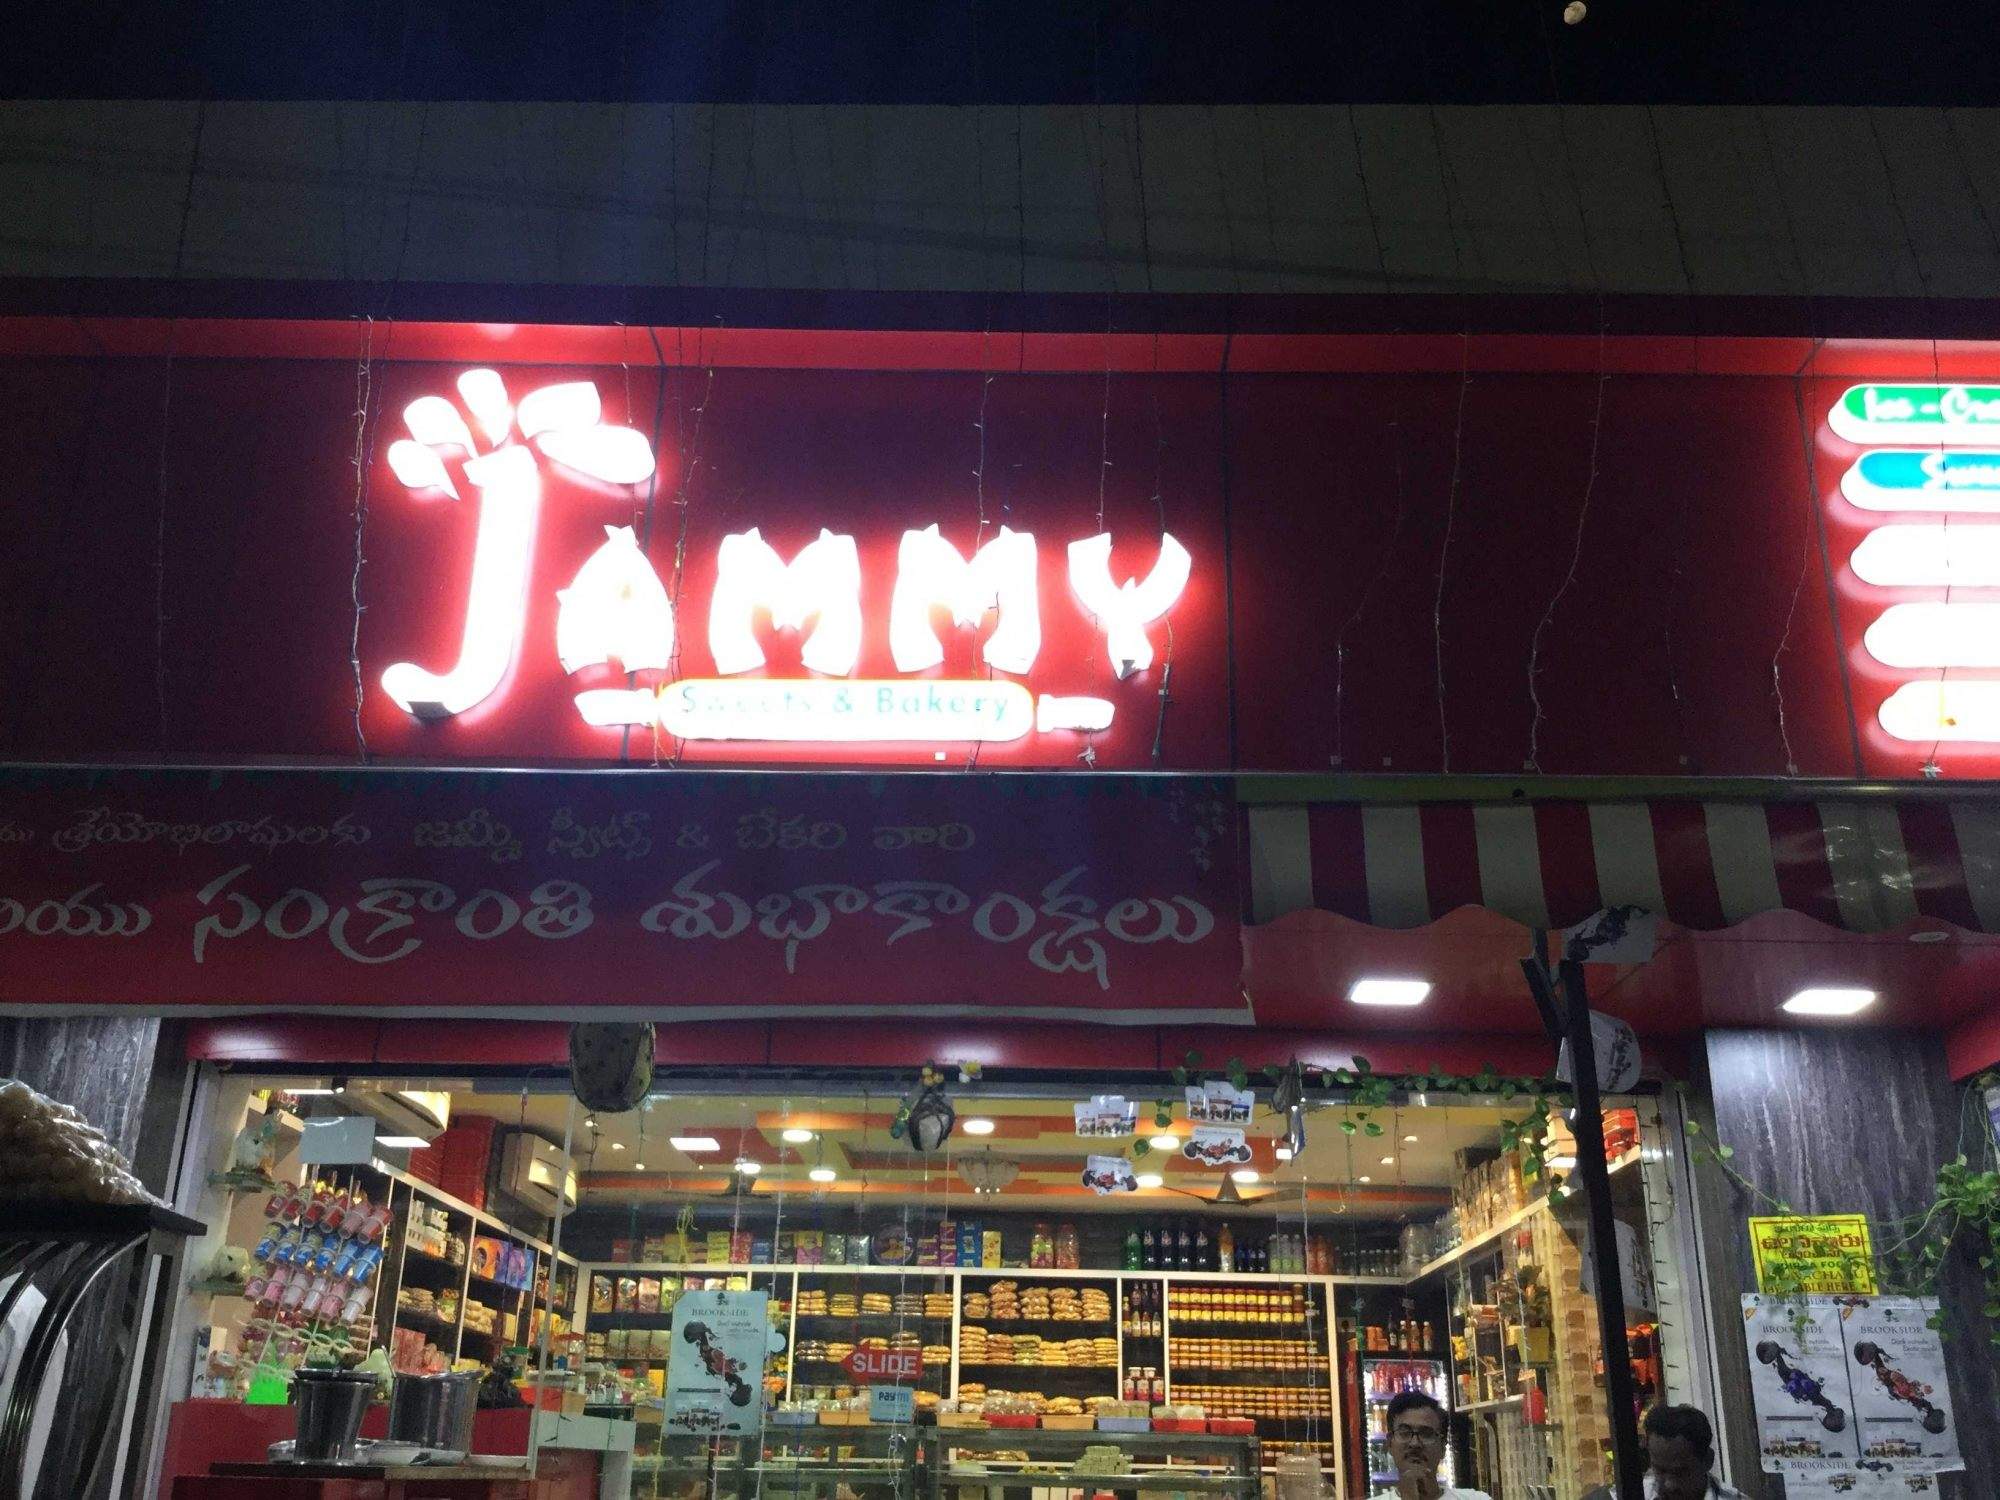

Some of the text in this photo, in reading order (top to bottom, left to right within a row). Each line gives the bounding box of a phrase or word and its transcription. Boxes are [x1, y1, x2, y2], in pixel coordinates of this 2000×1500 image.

[836, 687, 859, 714] &
[880, 683, 1017, 722] Bakery
[873, 823, 976, 850] వారి
[194, 863, 594, 963] సంక్రాంతి
[640, 858, 1214, 990] శుభాకాంక్షలు
[1827, 1281, 1856, 1292] HERE
[1860, 1325, 1923, 1335] BROOKSIDE
[852, 1353, 917, 1374] SLIDE
[1790, 1459, 1851, 1470] BROOKSIDE
